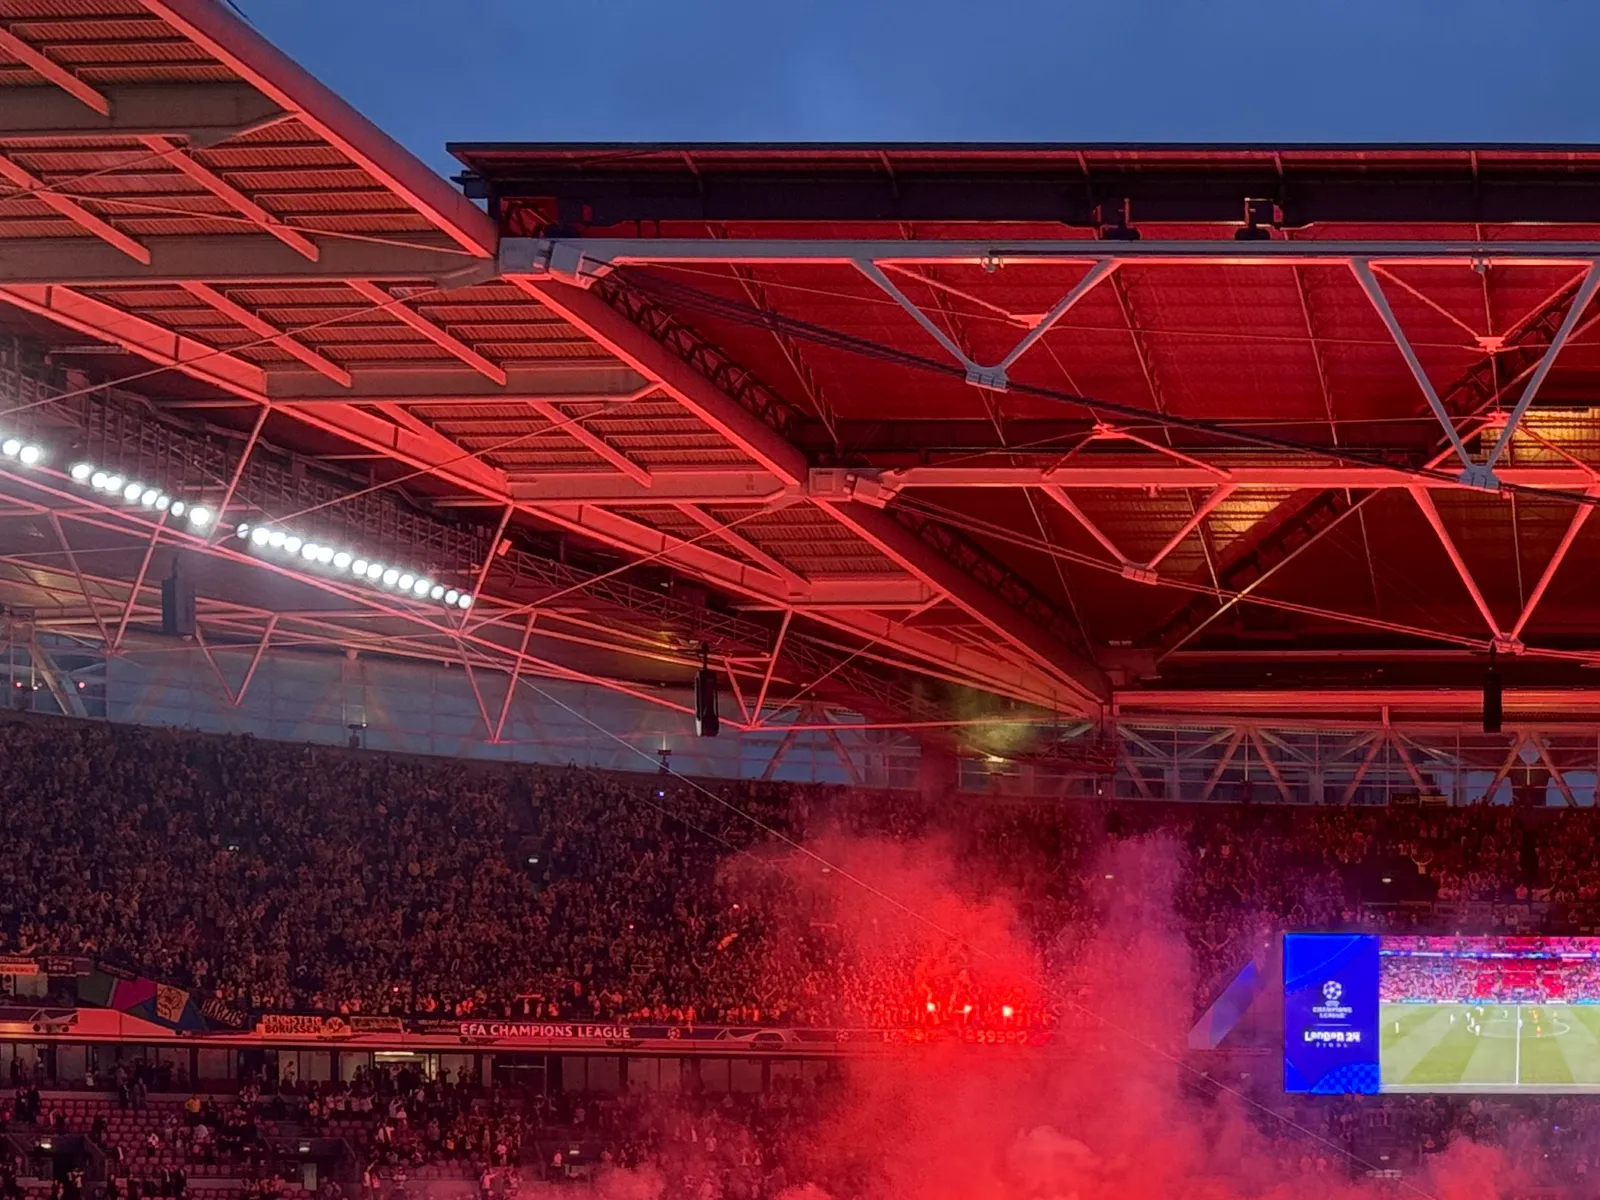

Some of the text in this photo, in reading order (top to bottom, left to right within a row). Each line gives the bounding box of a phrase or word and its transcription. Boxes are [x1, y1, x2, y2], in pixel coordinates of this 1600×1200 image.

[460, 1023, 488, 1036] EFA
[490, 1024, 573, 1038] CHAMPIONS
[577, 1025, 631, 1039] LEAGUE
